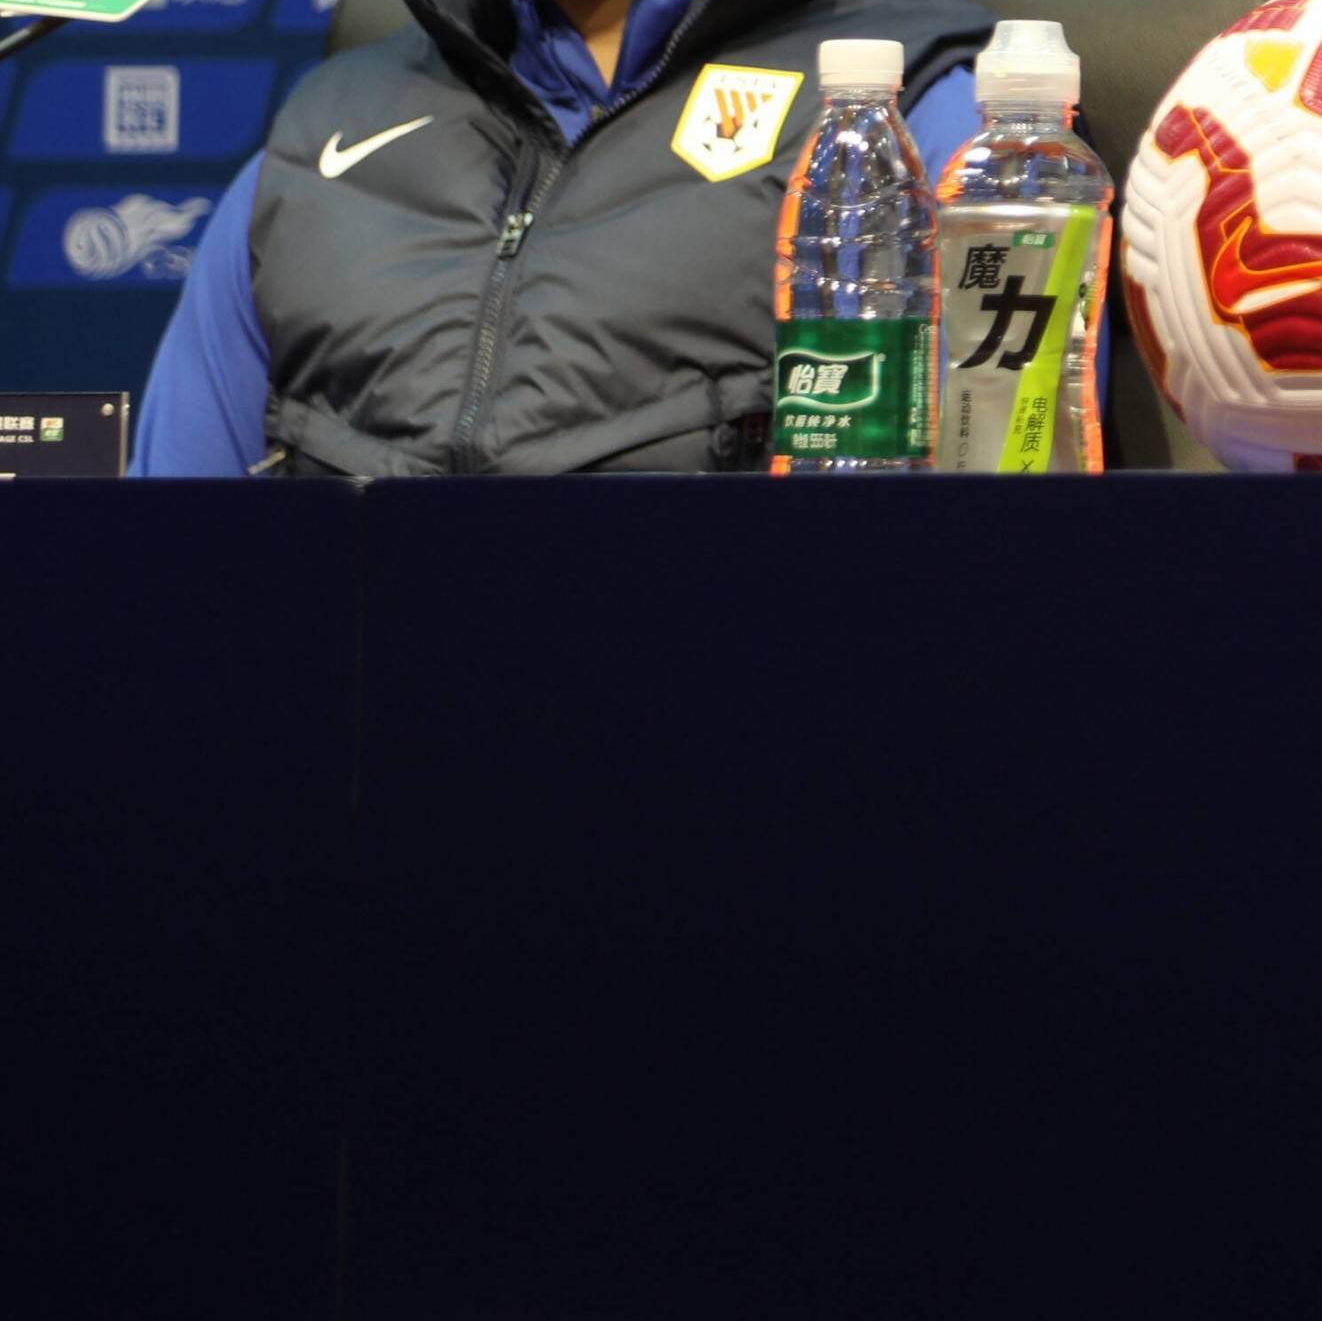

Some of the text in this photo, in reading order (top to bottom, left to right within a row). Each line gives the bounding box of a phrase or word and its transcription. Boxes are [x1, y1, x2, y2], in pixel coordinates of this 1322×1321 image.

[955, 242, 1058, 371] 魔力
[787, 364, 849, 395] 怡寶
[1021, 396, 1049, 453] 电解质
